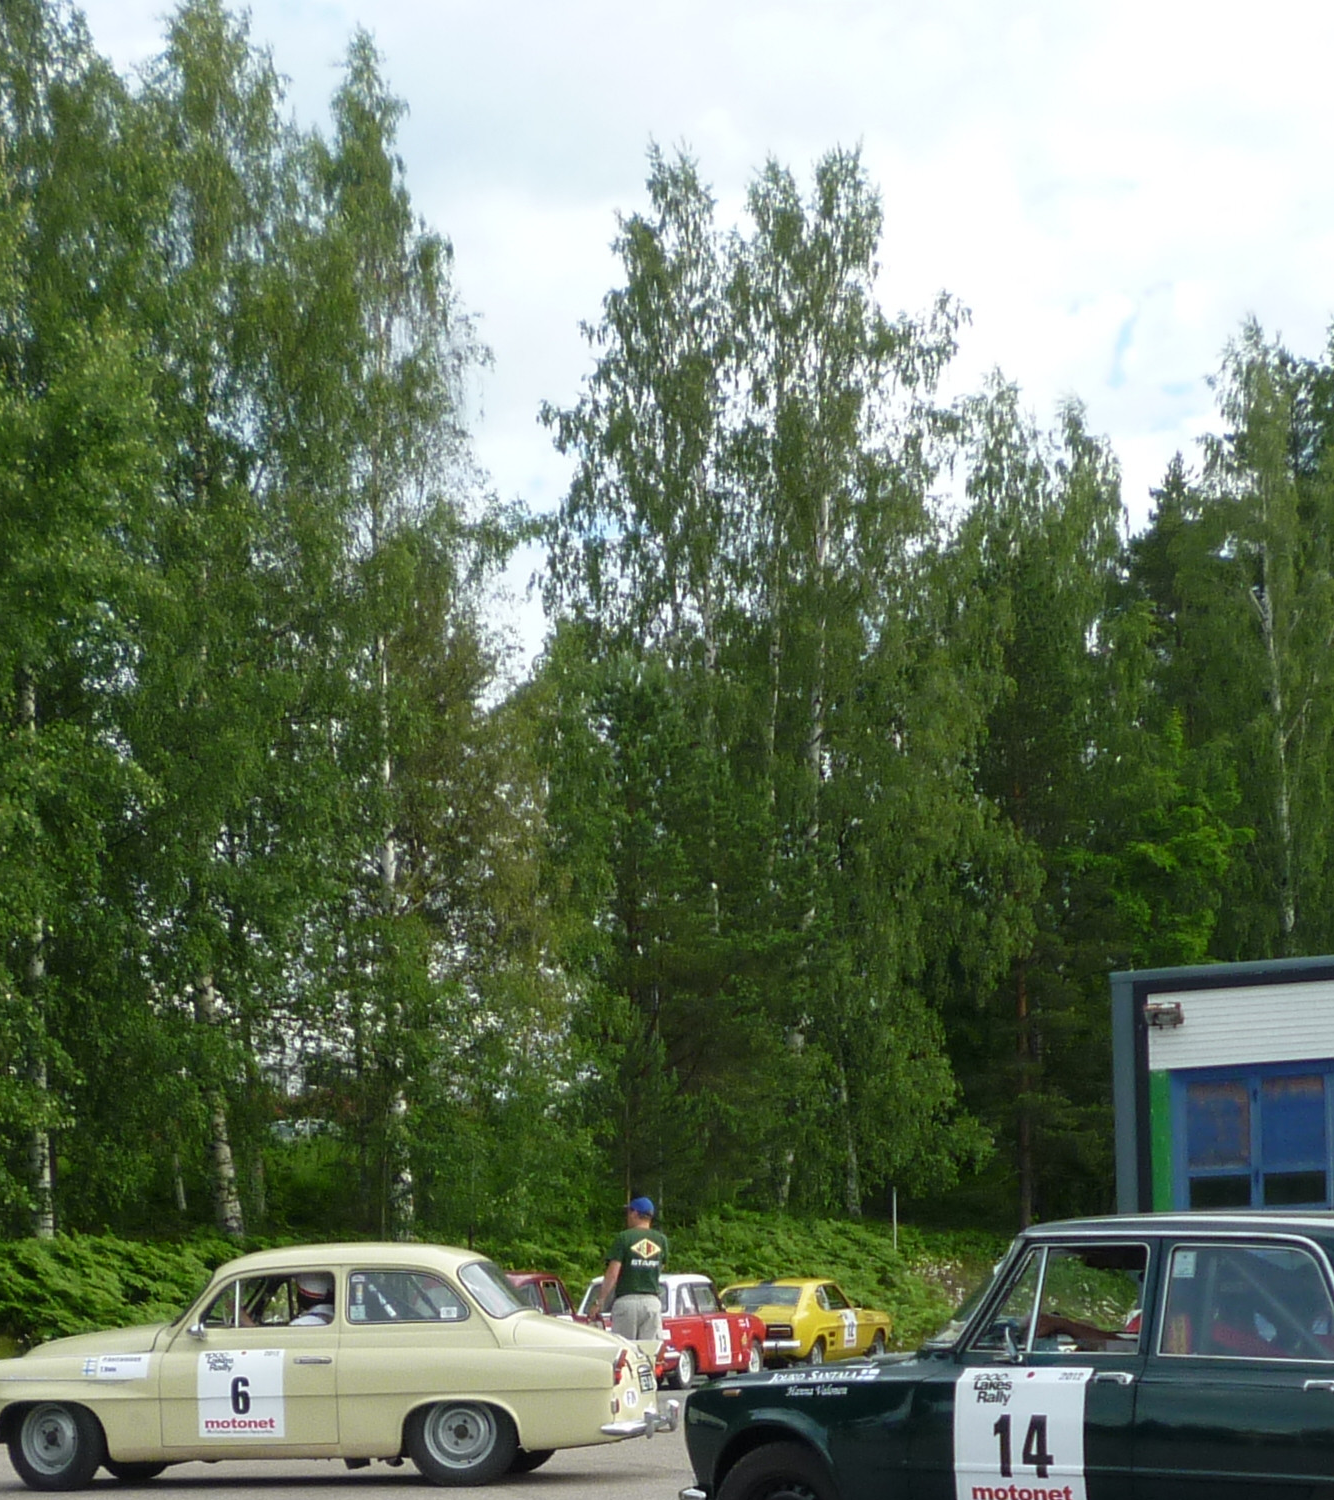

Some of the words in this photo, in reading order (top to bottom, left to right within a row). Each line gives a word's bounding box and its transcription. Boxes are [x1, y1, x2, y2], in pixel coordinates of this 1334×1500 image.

[974, 1381, 1013, 1391] Lakes
[231, 1376, 251, 1415] 6
[977, 1390, 1011, 1406] Rally
[204, 1418, 276, 1430] motonet
[993, 1414, 1054, 1479] 14
